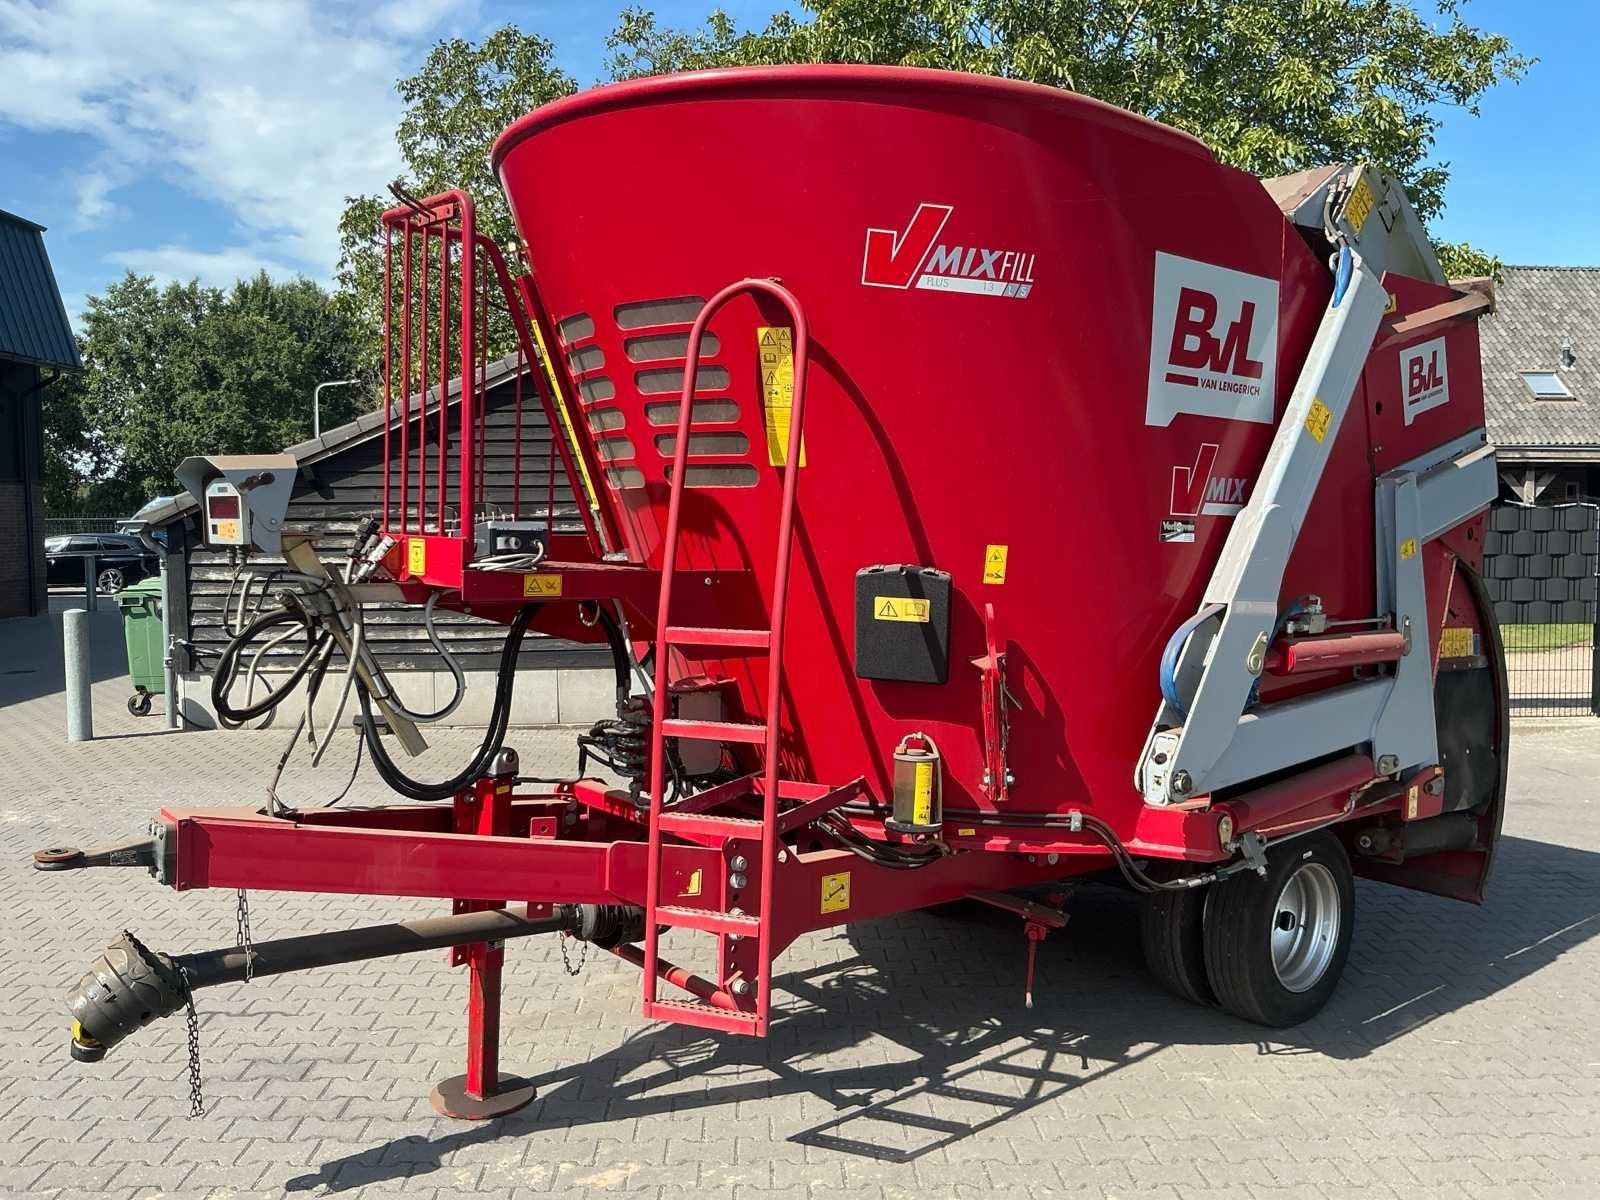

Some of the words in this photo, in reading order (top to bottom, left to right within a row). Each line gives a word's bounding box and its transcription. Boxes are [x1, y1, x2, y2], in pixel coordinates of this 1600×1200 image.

[926, 276, 950, 289] PLUS
[1200, 377, 1218, 390] VAN
[1218, 380, 1261, 396] LENGERICH
[1205, 477, 1247, 502] MIX
